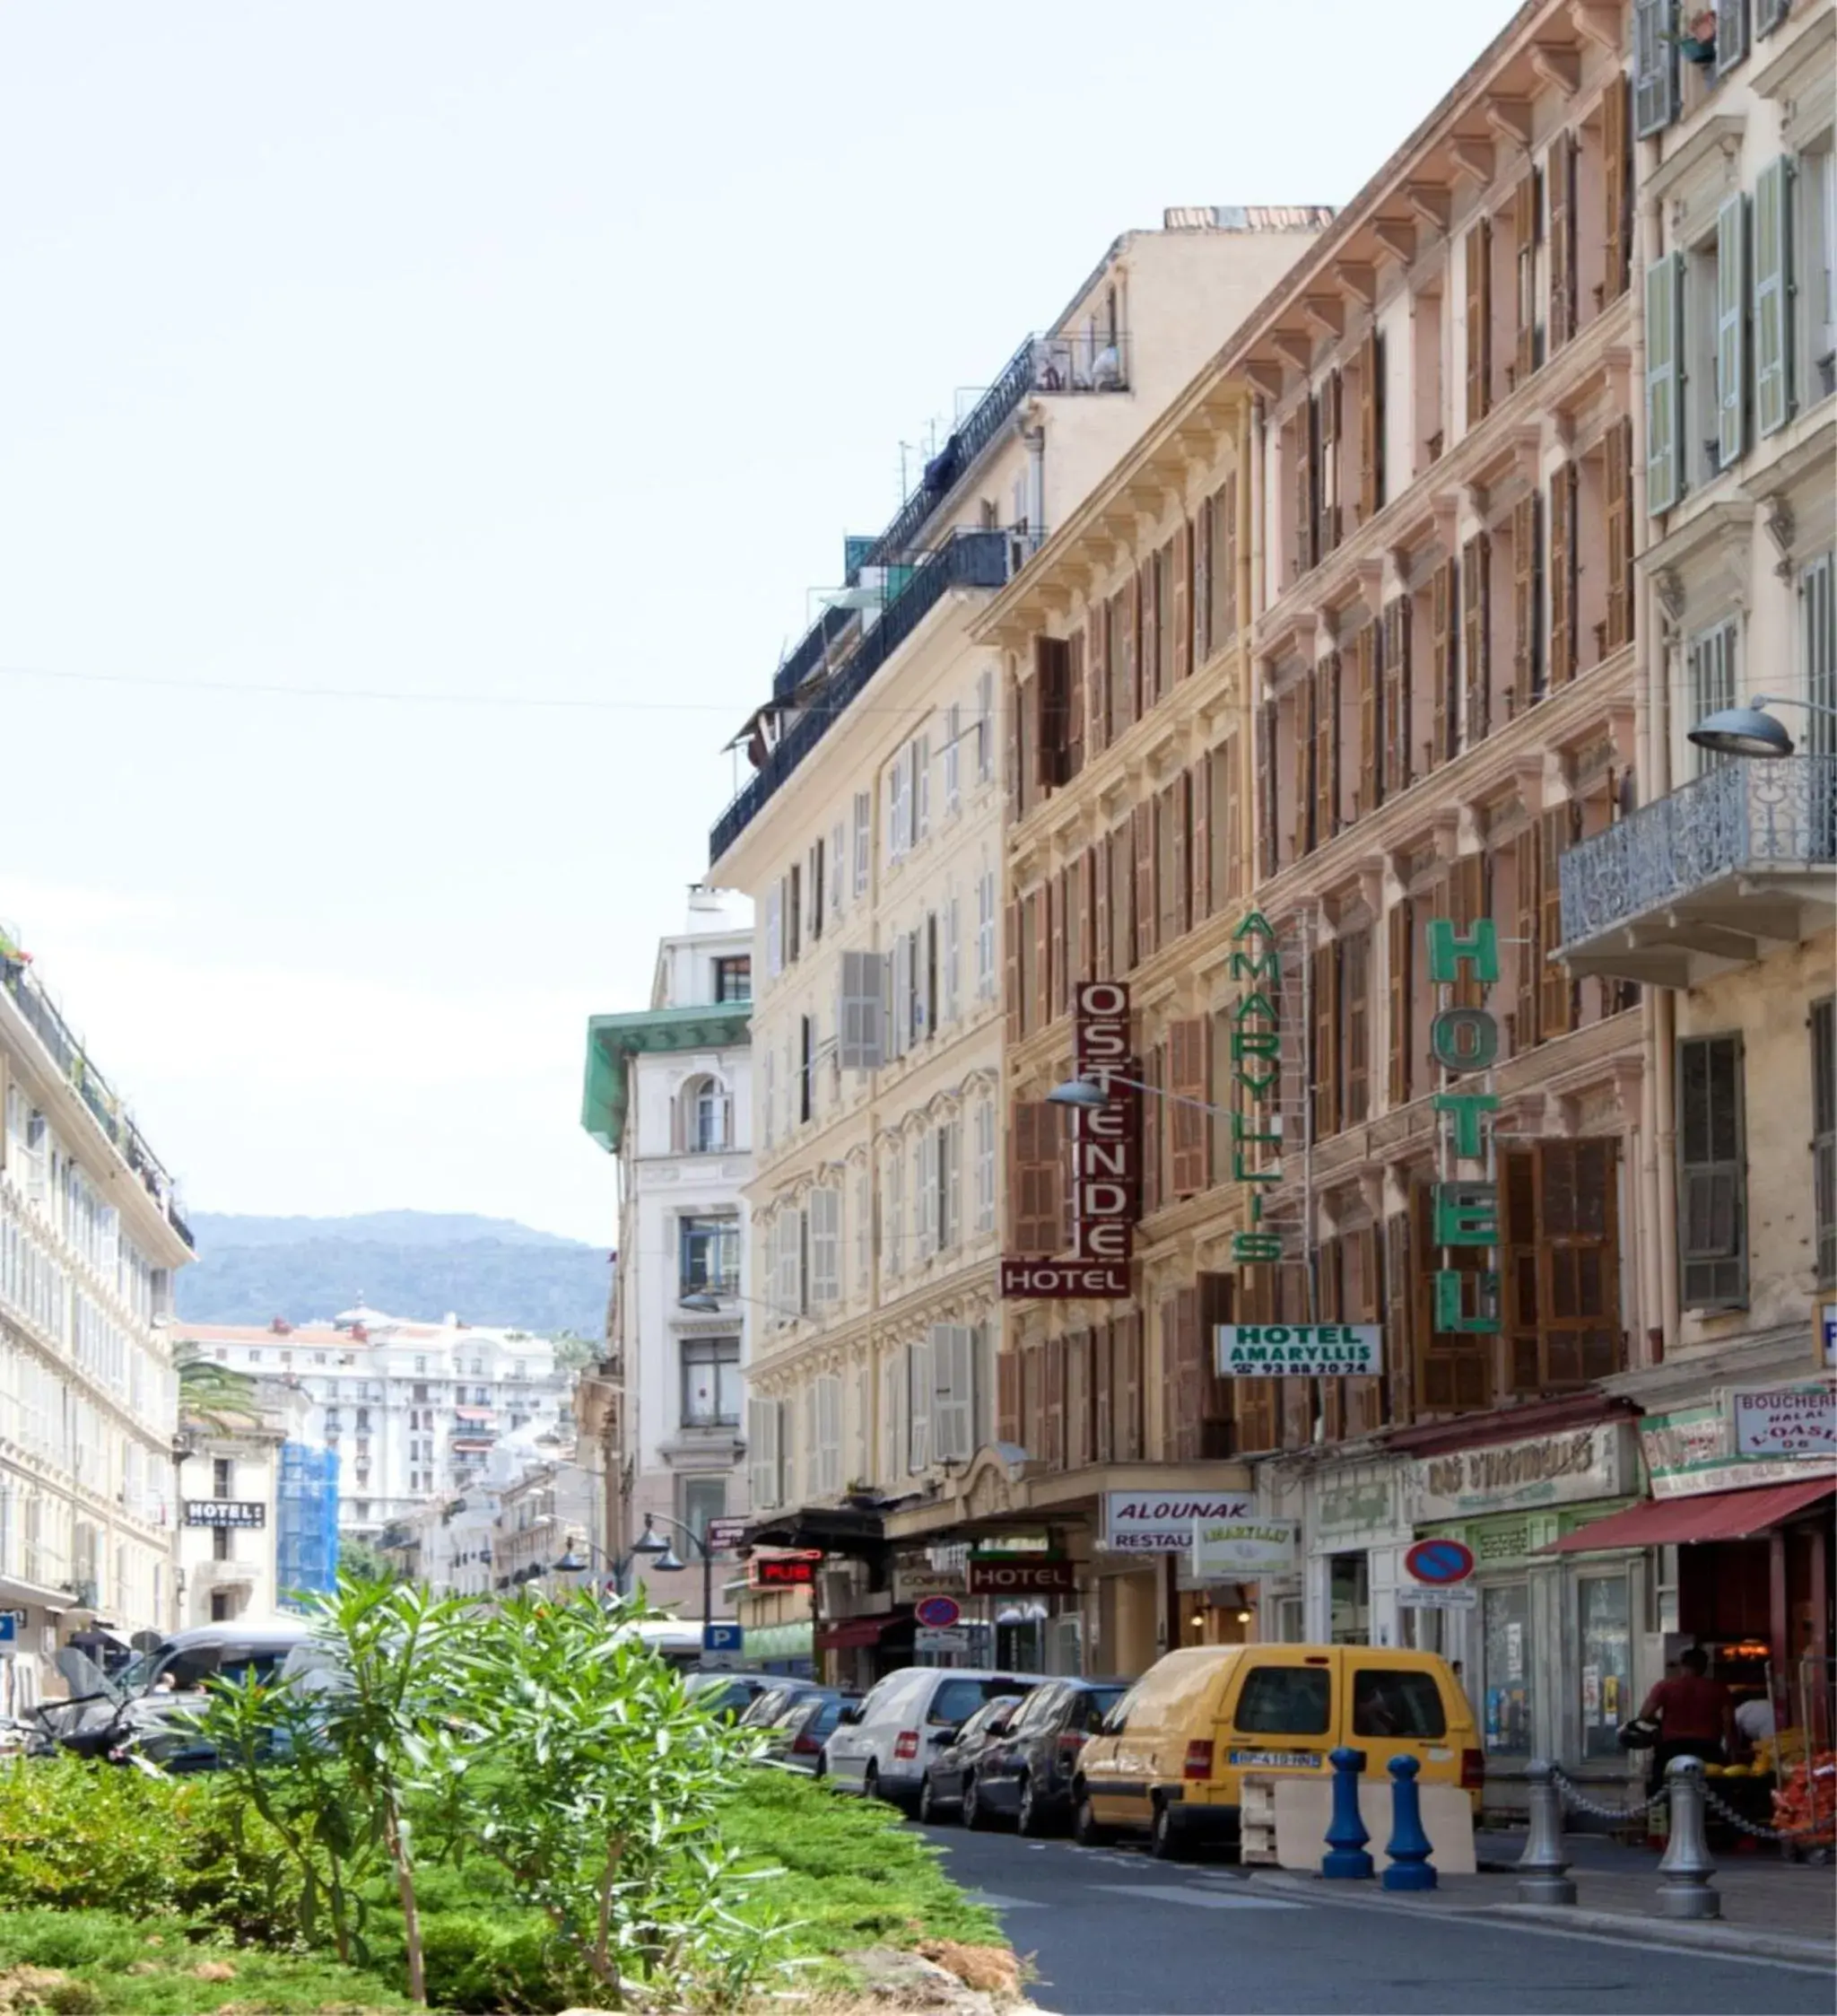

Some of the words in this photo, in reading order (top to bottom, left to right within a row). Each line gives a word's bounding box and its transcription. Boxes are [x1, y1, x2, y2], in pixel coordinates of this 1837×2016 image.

[1231, 912, 1283, 1262] AMARYLLIS
[1080, 984, 1127, 1254] OSTENDE
[1427, 917, 1502, 1334] HOTEL
[1005, 1270, 1127, 1290] HOTEL
[1236, 1327, 1363, 1344] HOTEL
[1230, 1347, 1371, 1362] AMARYLLIS
[1262, 1363, 1284, 1375] 93
[1290, 1363, 1311, 1375] 88
[1317, 1363, 1340, 1375] 20
[1344, 1363, 1368, 1375] 24
[1768, 1411, 1827, 1423] HALAL
[1750, 1424, 1836, 1447] L'OASI
[189, 1503, 252, 1519] HOTEL
[1117, 1502, 1249, 1519] ALOUNAK
[766, 1564, 811, 1579] PUB
[974, 1569, 1067, 1585] HOTEL
[713, 1629, 731, 1647] P
